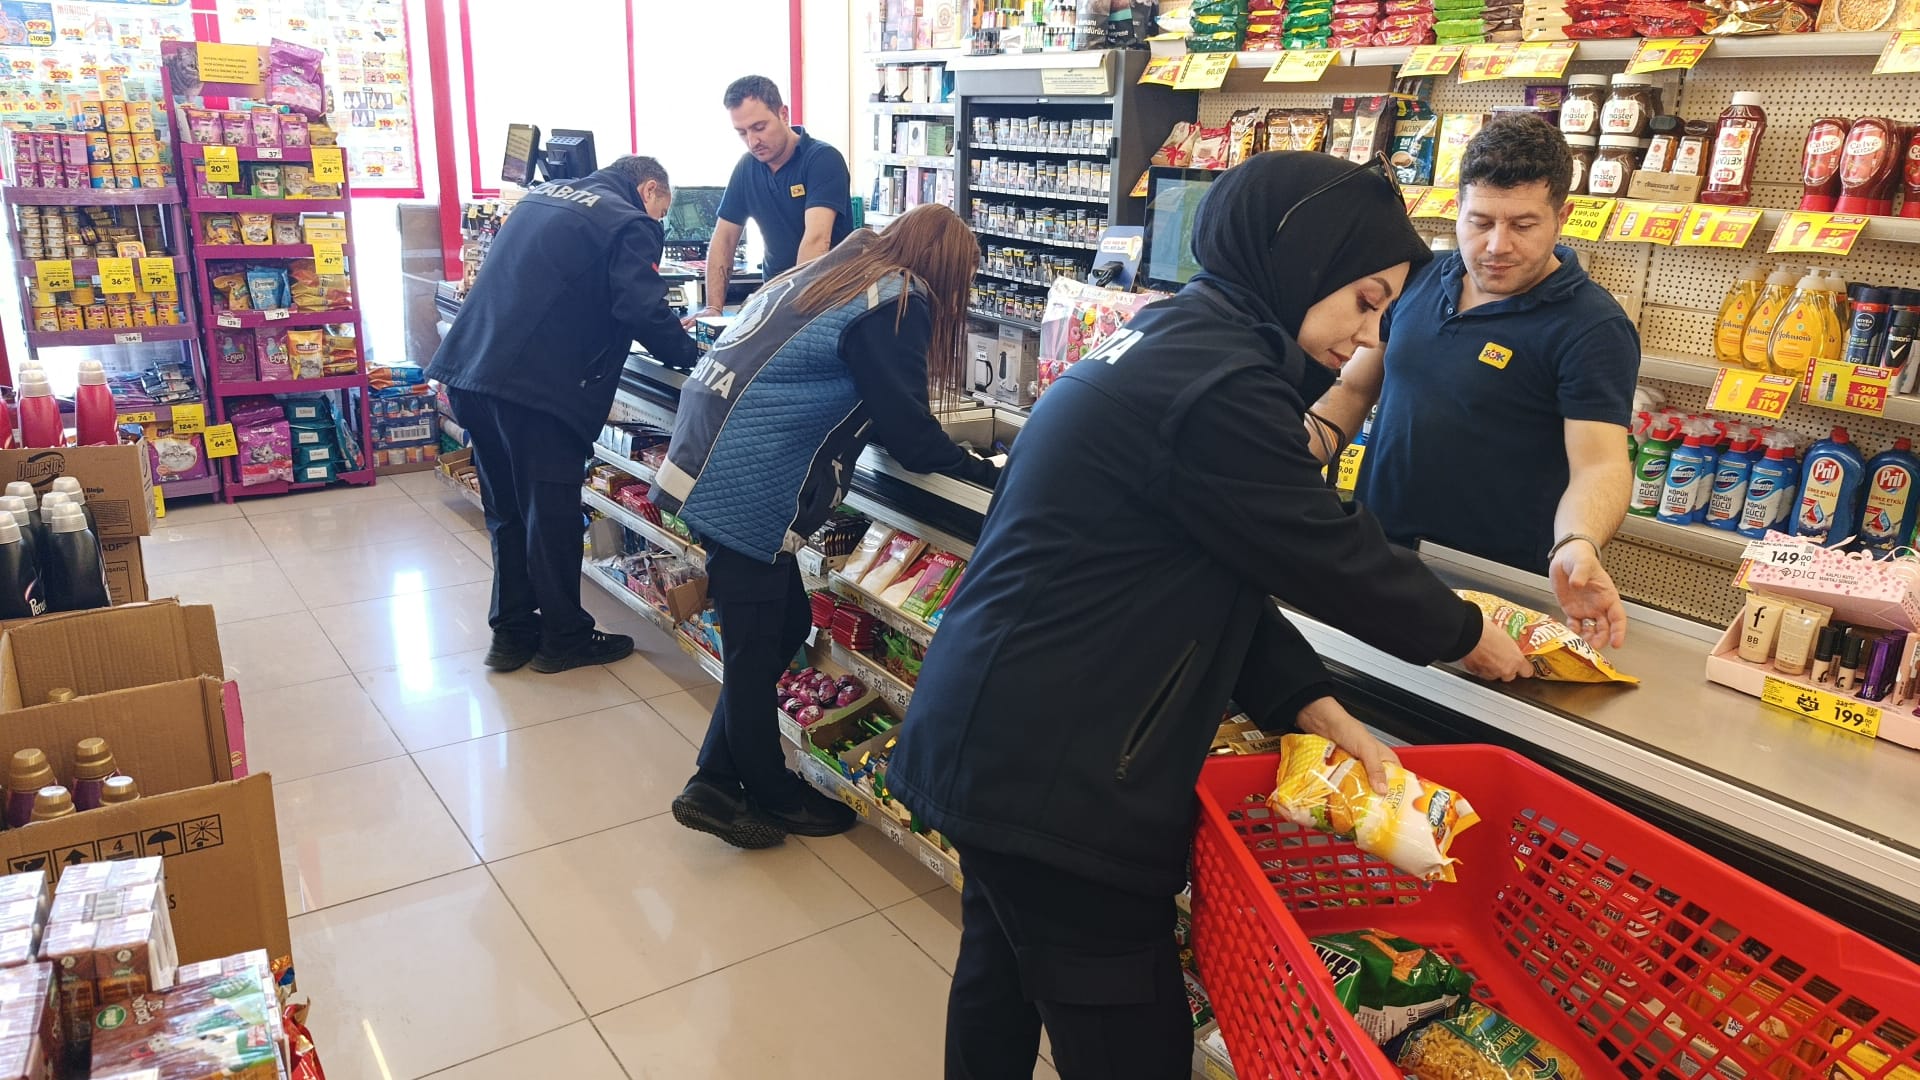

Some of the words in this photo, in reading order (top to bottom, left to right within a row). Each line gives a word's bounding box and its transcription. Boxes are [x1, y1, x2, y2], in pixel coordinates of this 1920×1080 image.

[531, 182, 601, 207] ZABITA
[1568, 219, 1597, 228] 29,00
[1649, 227, 1672, 239] 199
[1718, 231, 1736, 242] 80
[1822, 237, 1843, 247] 50
[1860, 386, 1878, 395] 349
[1757, 399, 1779, 411] 119
[1852, 395, 1879, 408] 199
[17, 457, 65, 481] Domestos
[1815, 462, 1837, 479] Pril
[1880, 470, 1904, 487] Pril
[1666, 495, 1688, 504] GÜCÜ
[1711, 501, 1732, 510] GÜCÜ
[1745, 509, 1766, 518] GÜCÜ
[1771, 551, 1799, 565] 149
[1746, 635, 1759, 645] BB
[1835, 707, 1864, 726] 199
